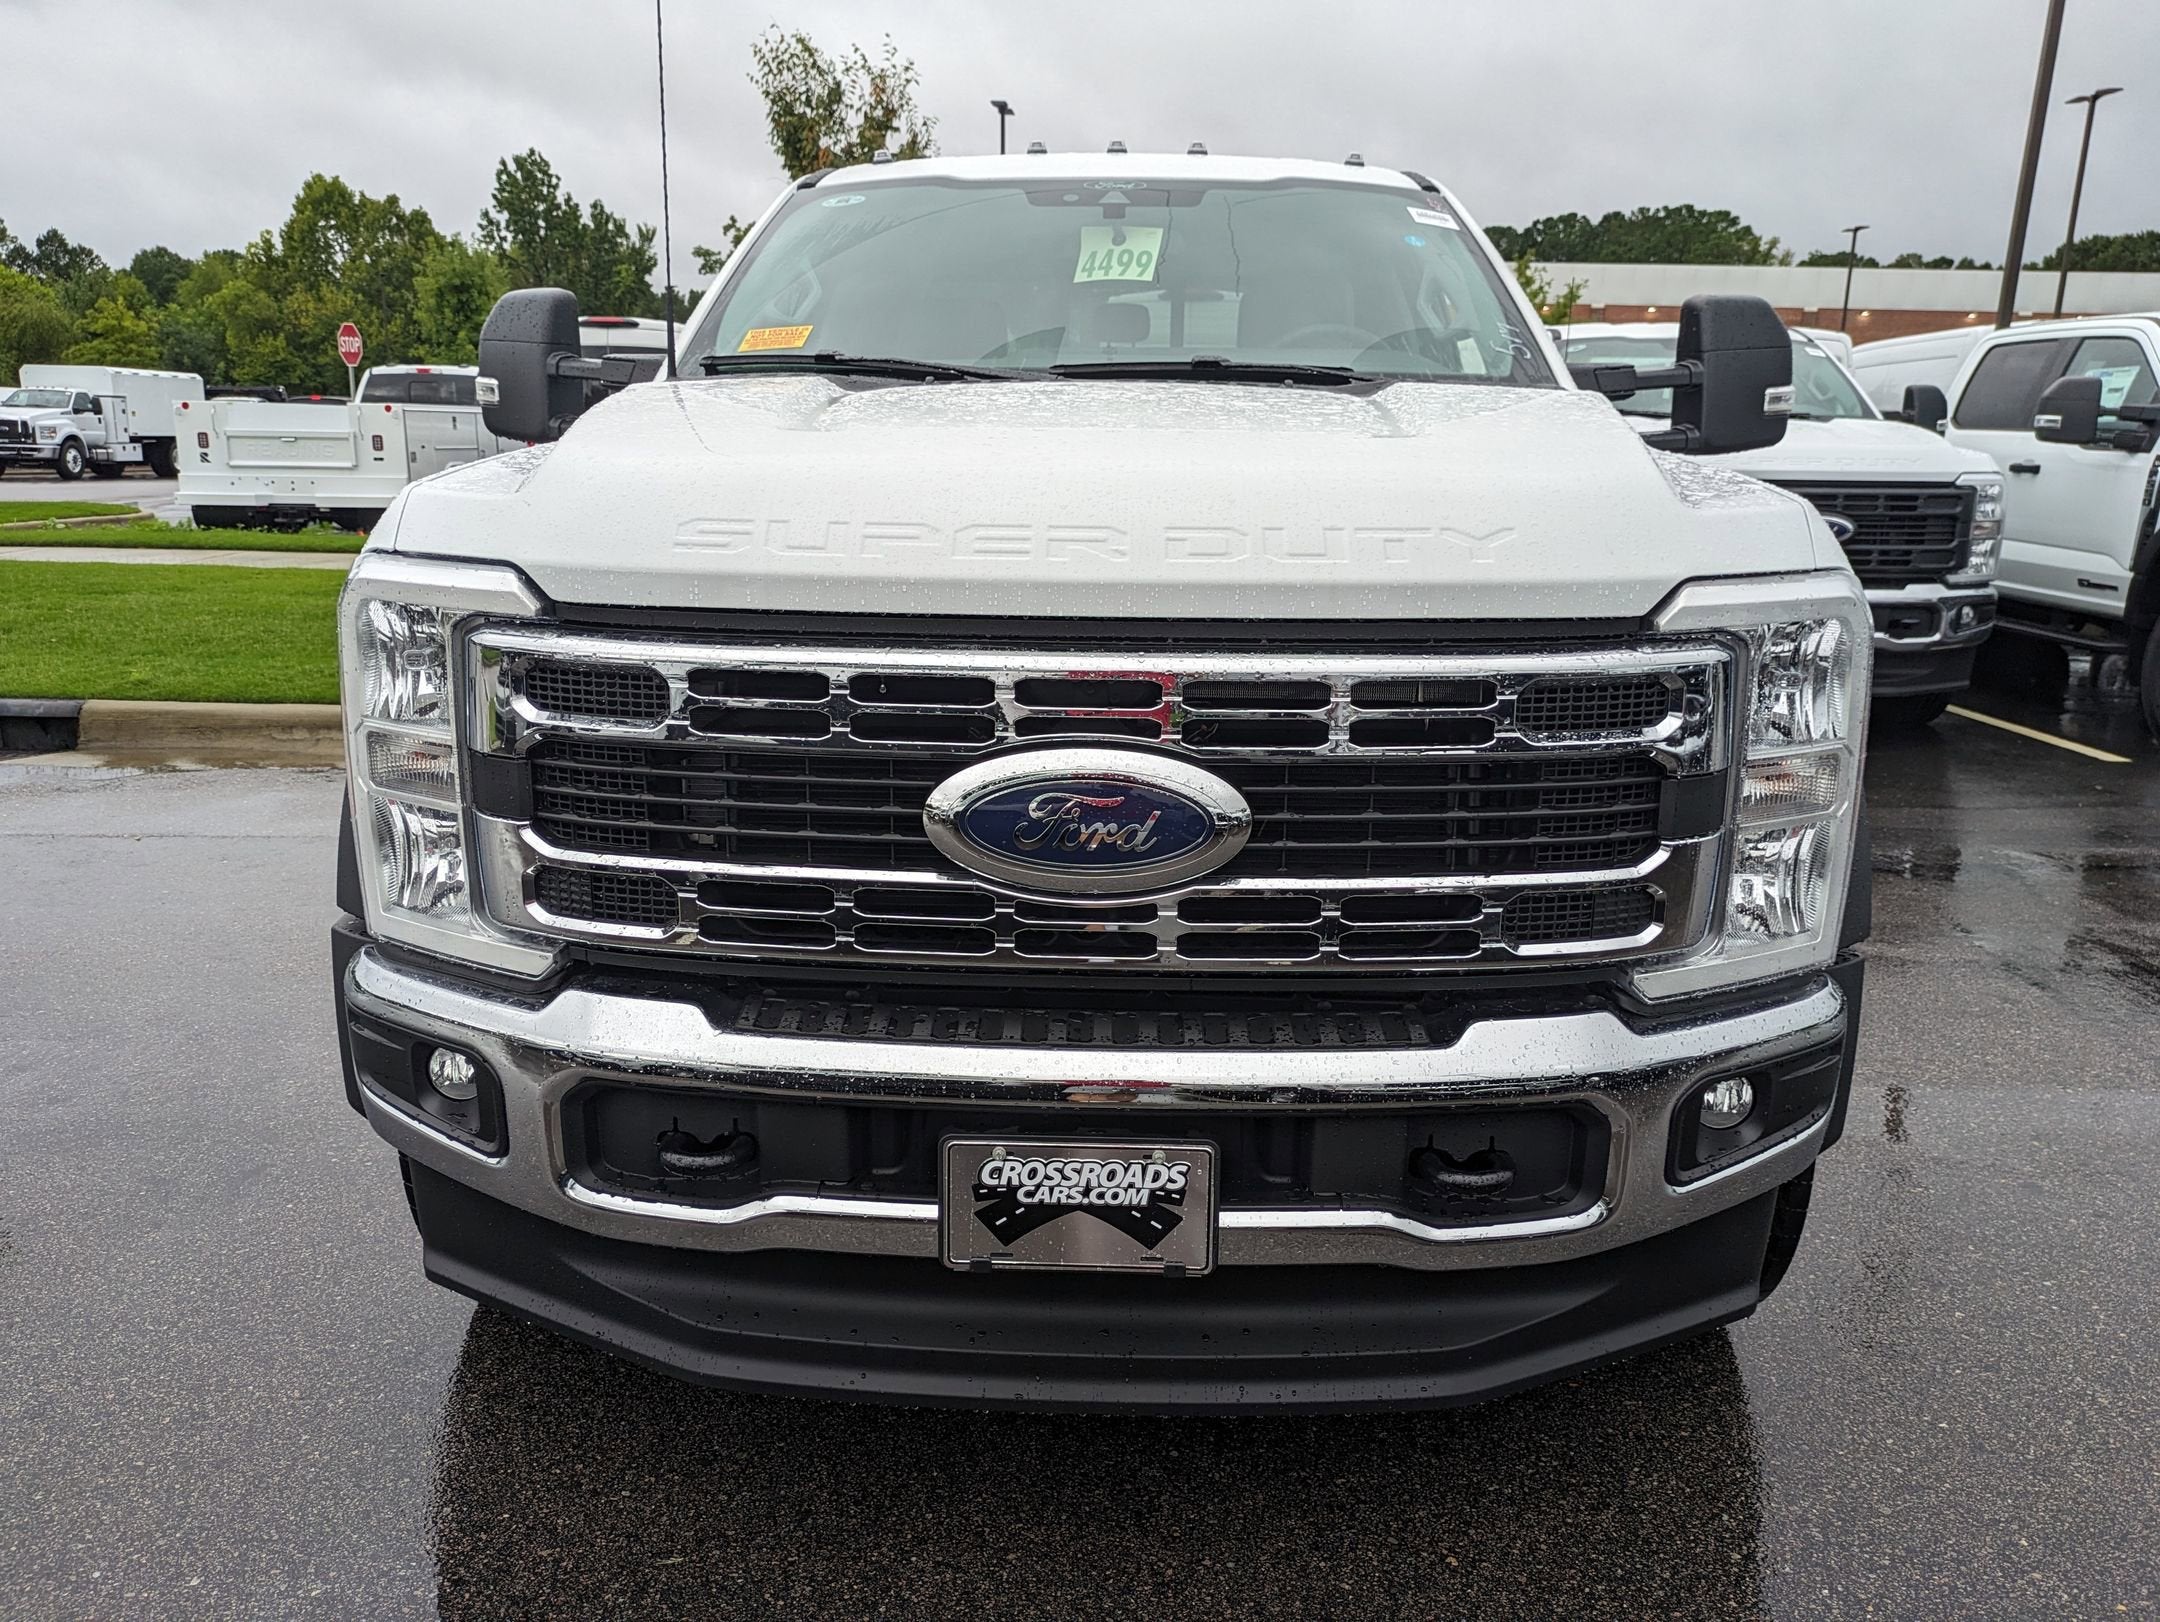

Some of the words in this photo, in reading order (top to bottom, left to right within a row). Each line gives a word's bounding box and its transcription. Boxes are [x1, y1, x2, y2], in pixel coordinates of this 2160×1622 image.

[1080, 248, 1154, 279] 4499
[340, 336, 361, 353] STOP
[672, 517, 1129, 561] SUPER
[1163, 525, 1518, 563] DUTY
[1012, 791, 1163, 853] Ford
[979, 1158, 1189, 1191] CROSSROADS
[1015, 1185, 1151, 1207] CARS.COM
